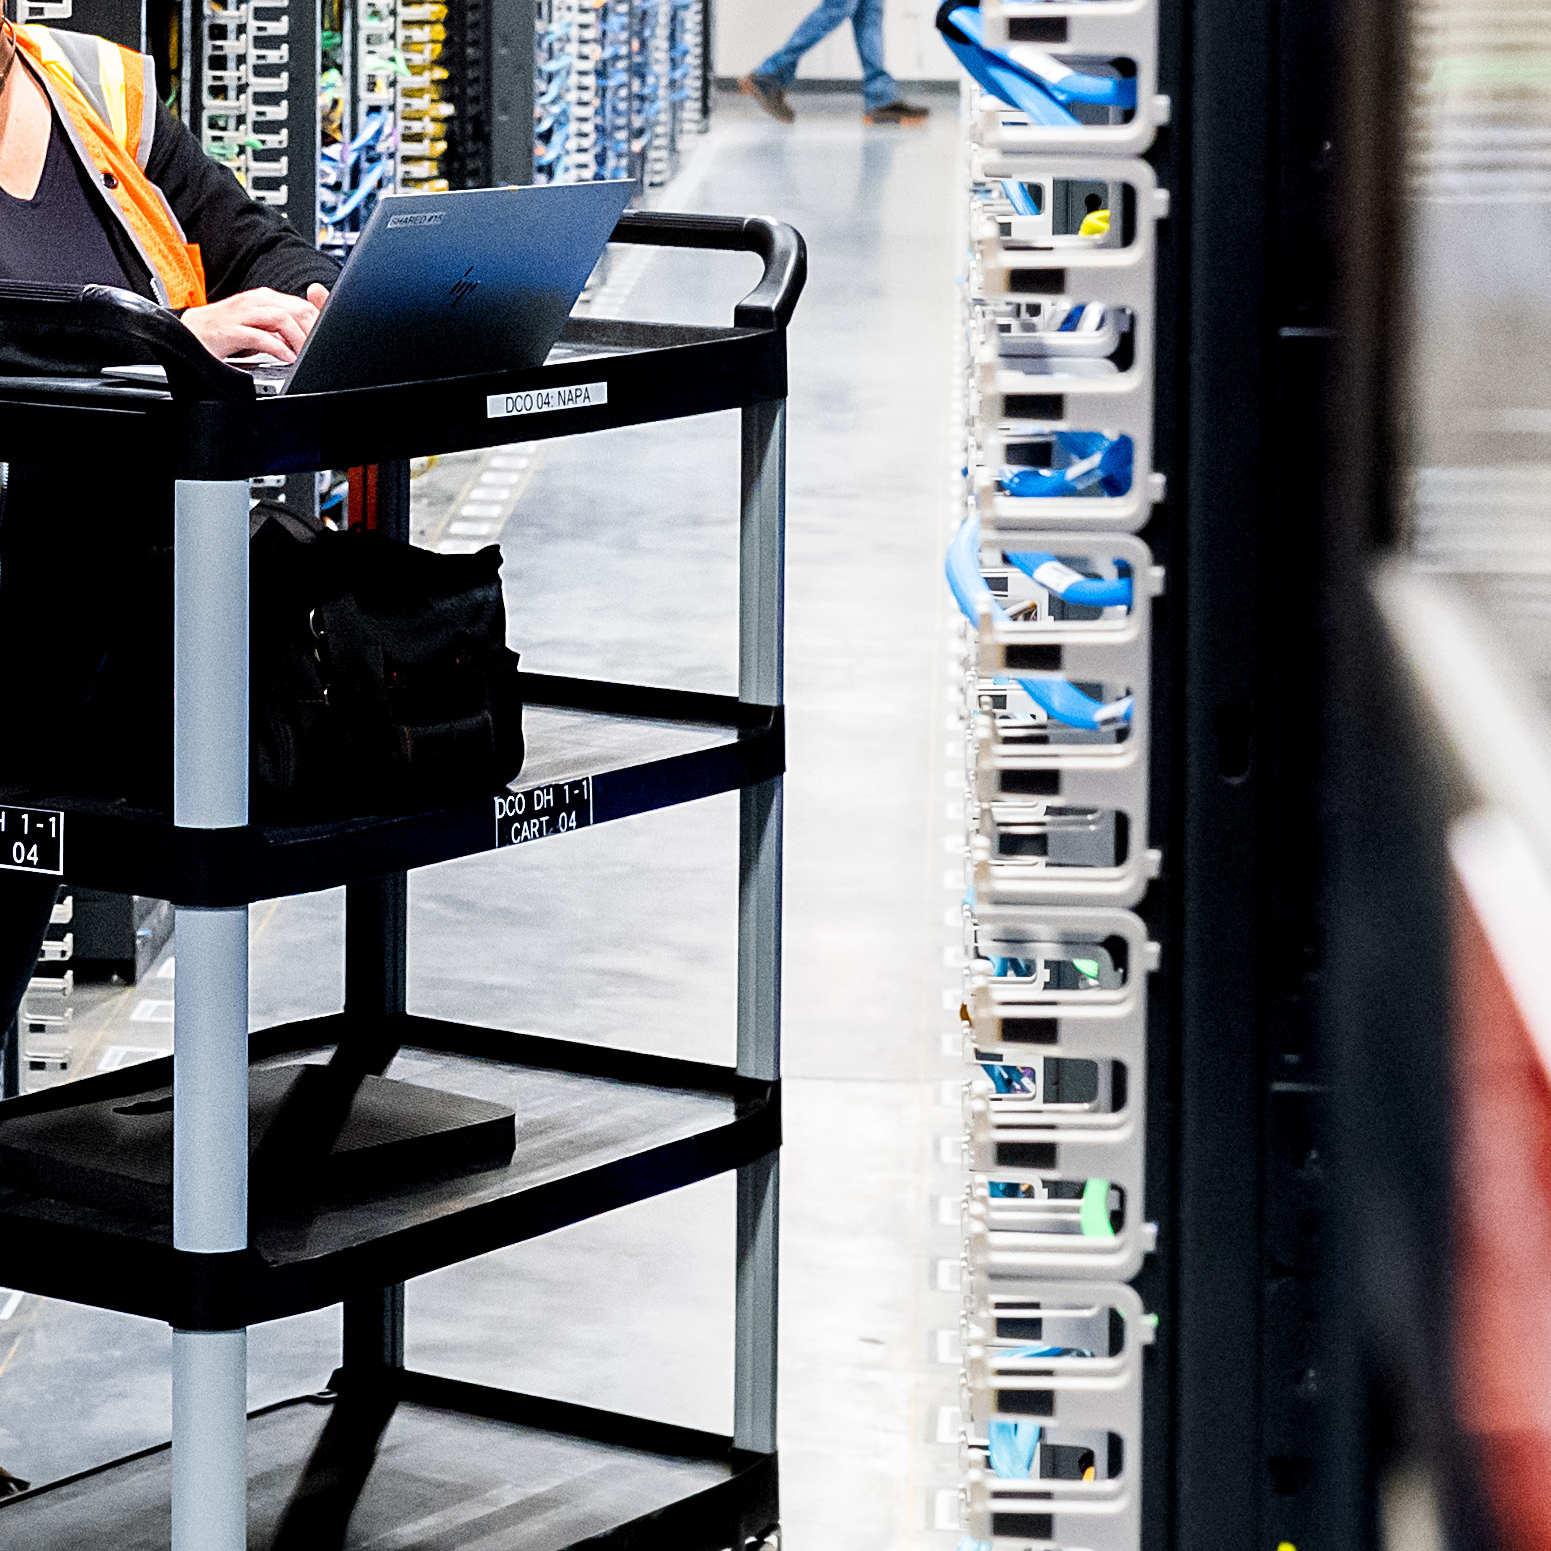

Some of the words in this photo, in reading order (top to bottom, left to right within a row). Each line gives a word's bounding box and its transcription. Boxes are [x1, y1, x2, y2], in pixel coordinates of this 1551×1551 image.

[390, 215, 427, 226] SHARED
[505, 392, 533, 413] DCO
[536, 390, 554, 410] 04:
[557, 387, 591, 407] NAPA
[495, 792, 525, 819] DCO
[534, 787, 553, 810] DH
[511, 815, 549, 844] CART
[559, 810, 576, 833] 04
[12, 841, 38, 865] 04
